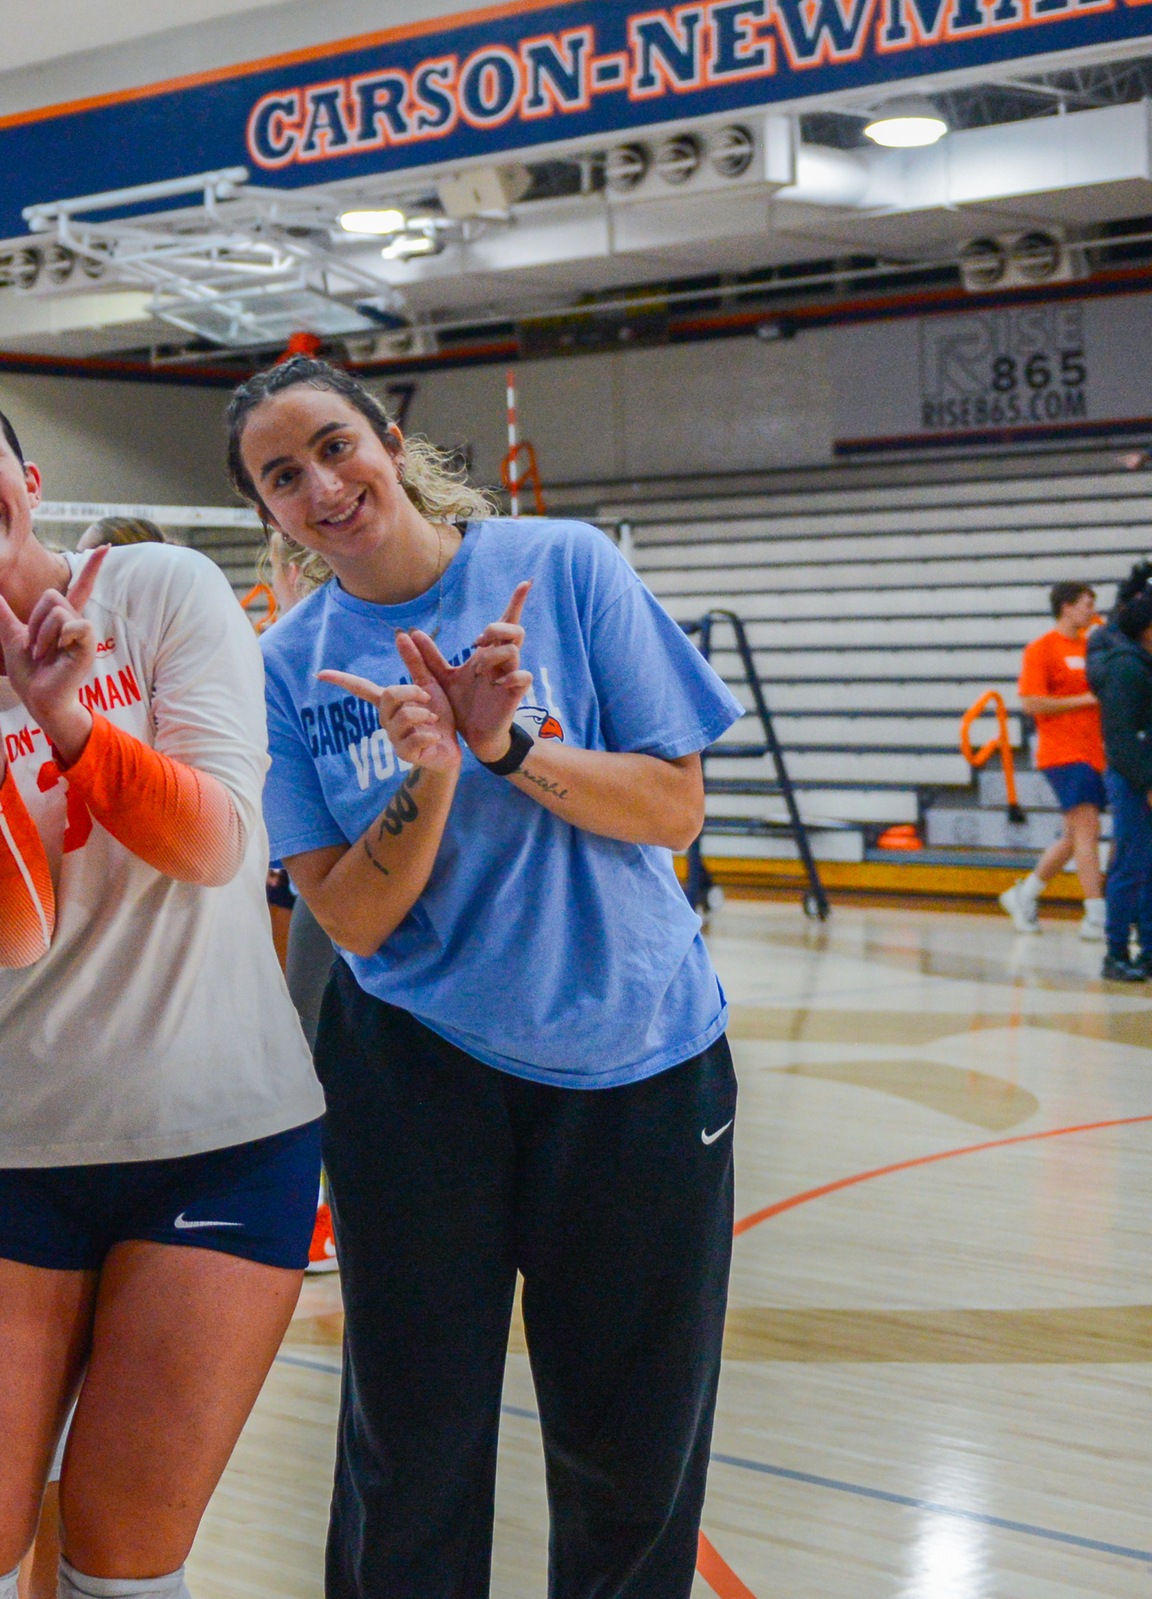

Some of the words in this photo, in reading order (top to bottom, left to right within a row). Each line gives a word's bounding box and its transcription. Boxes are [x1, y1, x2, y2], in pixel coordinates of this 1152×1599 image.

[247, 0, 1152, 168] CARSON-NEWM
[991, 350, 1088, 393] 865
[388, 382, 417, 432] 7
[96, 637, 116, 653] AC
